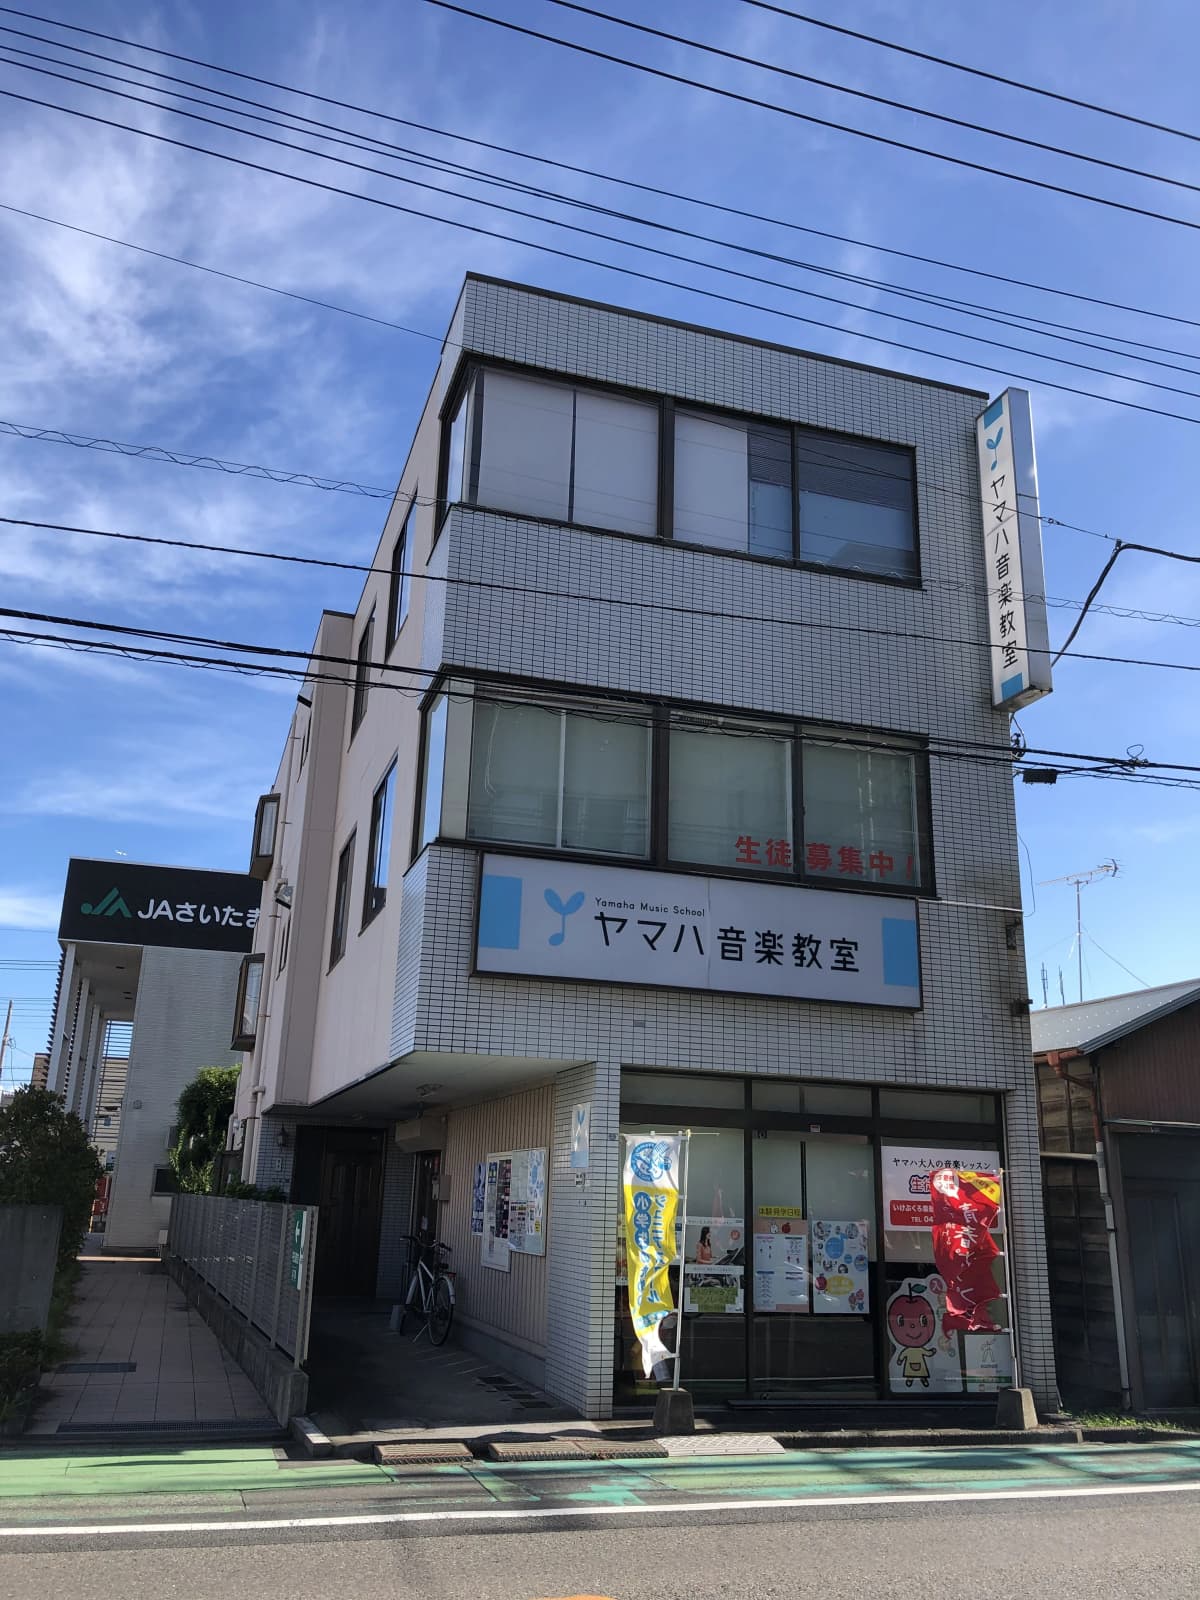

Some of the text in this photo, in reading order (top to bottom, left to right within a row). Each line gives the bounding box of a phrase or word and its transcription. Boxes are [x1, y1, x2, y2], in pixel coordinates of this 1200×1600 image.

[990, 474, 1018, 669] ヤマハ音楽教室
[595, 897, 705, 917] Yamaha Music School
[594, 911, 859, 972] ヤマハ音楽教室
[893, 1157, 991, 1170] ヤマハ大人の音楽レッスン
